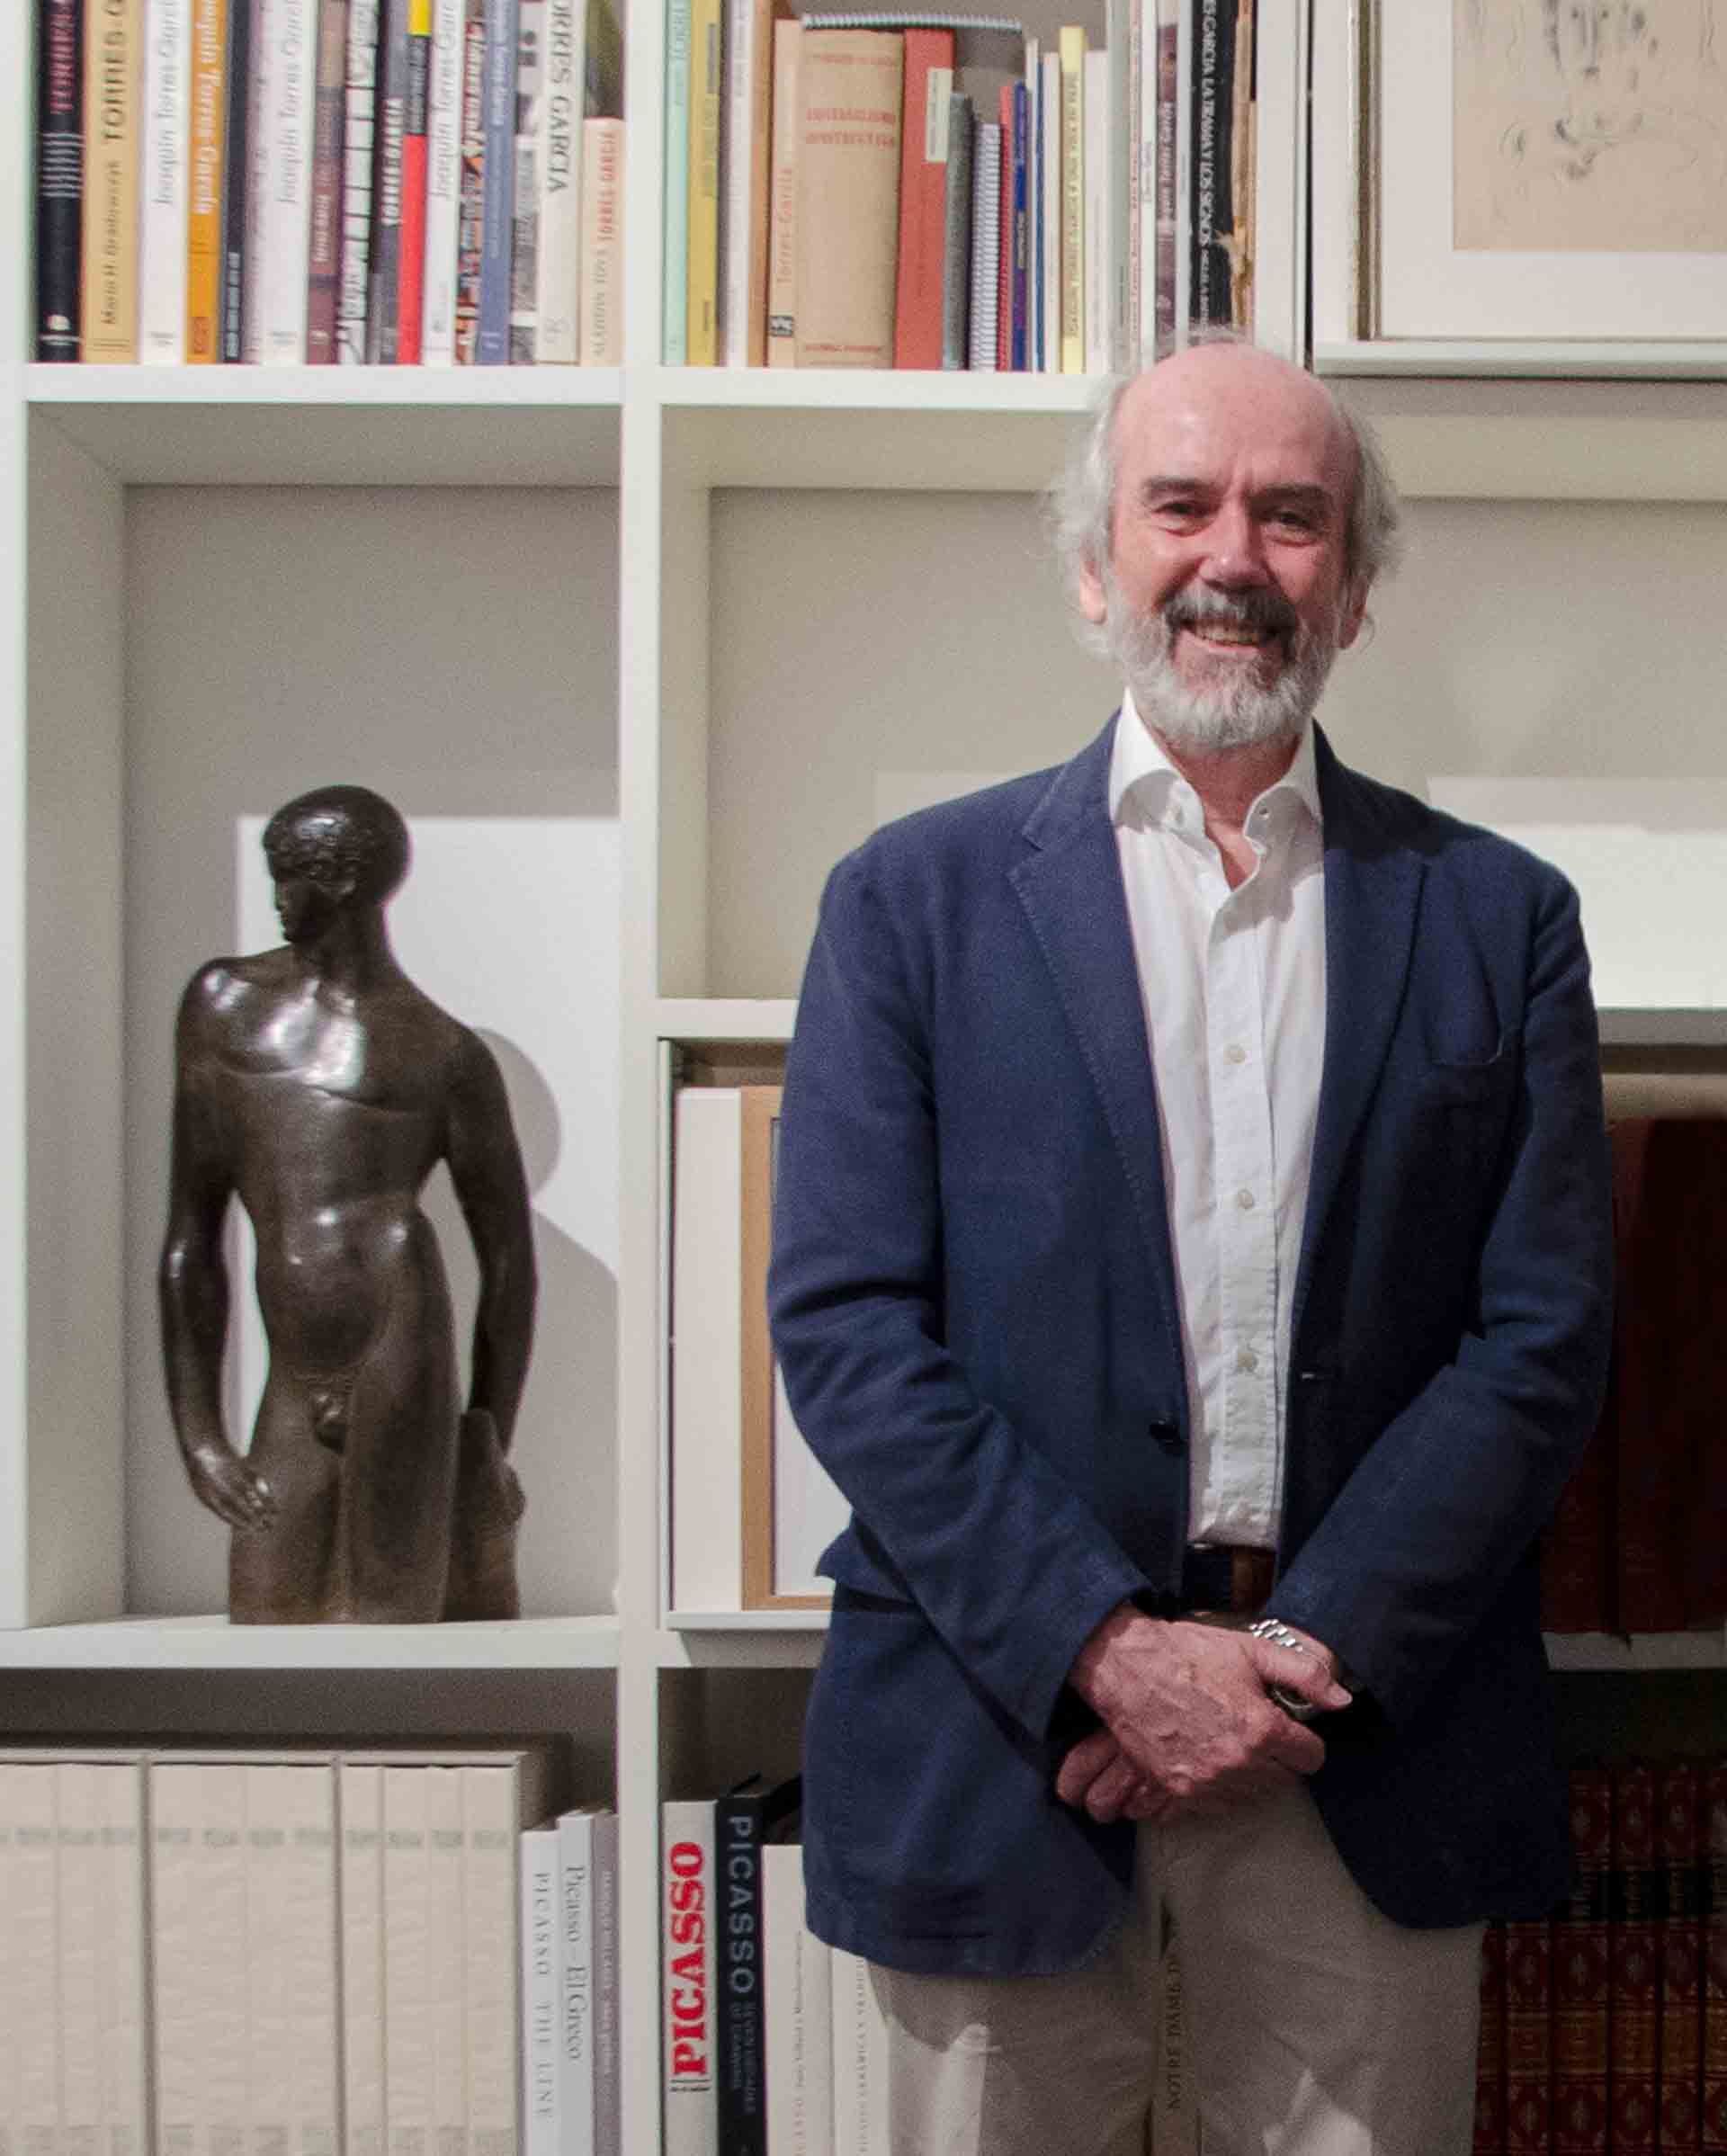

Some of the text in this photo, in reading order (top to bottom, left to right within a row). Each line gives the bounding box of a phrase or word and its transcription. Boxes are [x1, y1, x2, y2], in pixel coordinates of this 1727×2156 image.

[534, 1872, 553, 1977] PICASSO
[565, 1865, 586, 1944] Picasso
[669, 1841, 707, 2077] PICASSO
[728, 1816, 756, 1994] PICASSO
